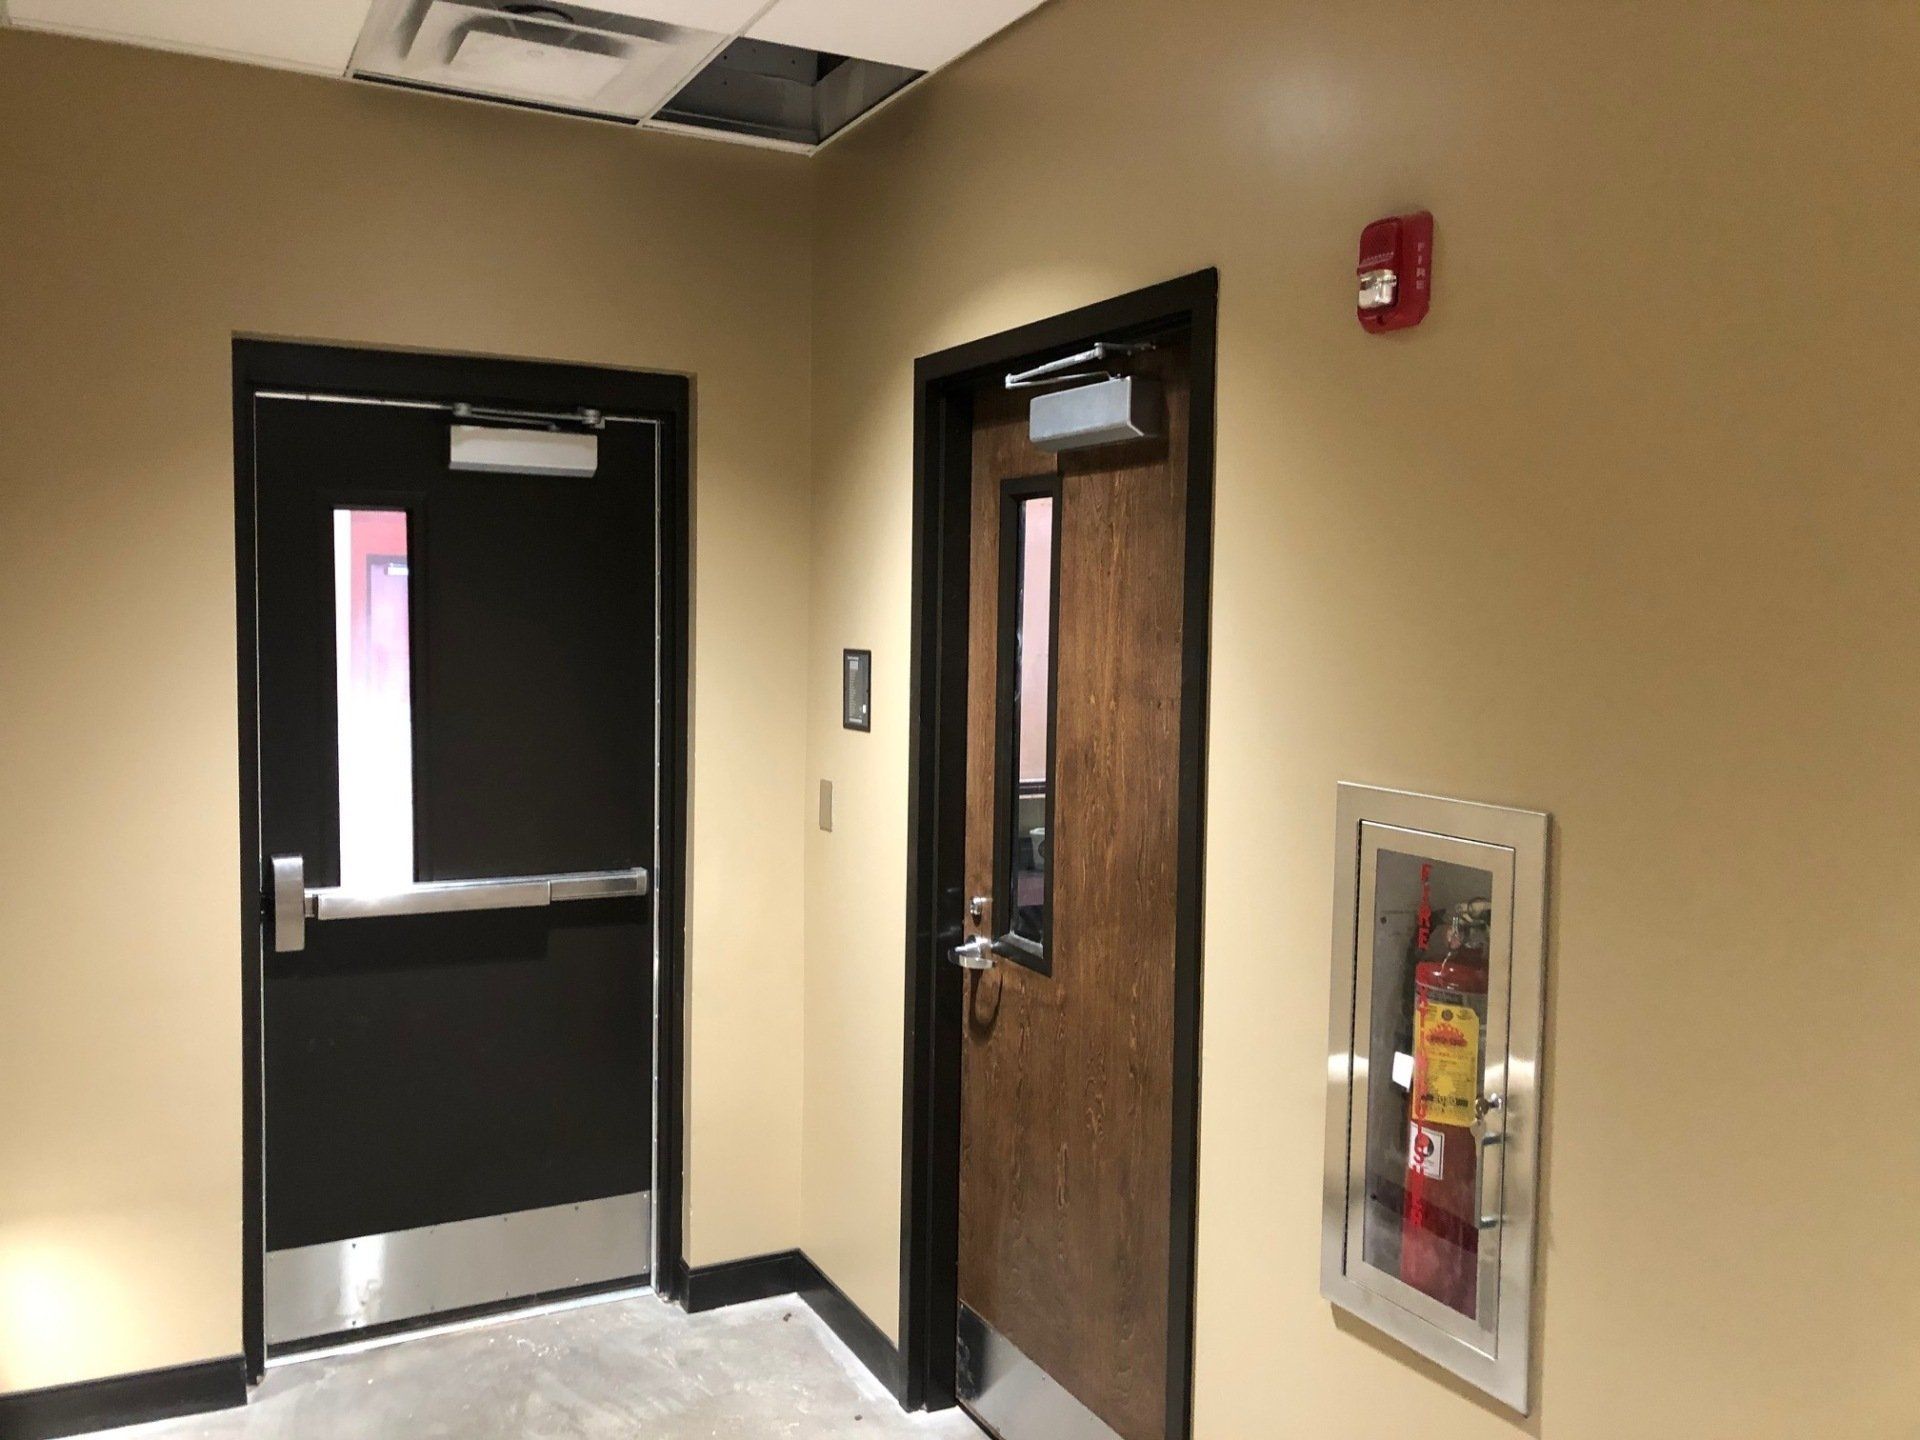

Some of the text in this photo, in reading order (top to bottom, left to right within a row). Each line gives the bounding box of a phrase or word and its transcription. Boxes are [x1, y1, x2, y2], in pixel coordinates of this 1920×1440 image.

[1416, 242, 1426, 290] FIRE
[1411, 863, 1432, 1226] FIRE XTINGUISHER
